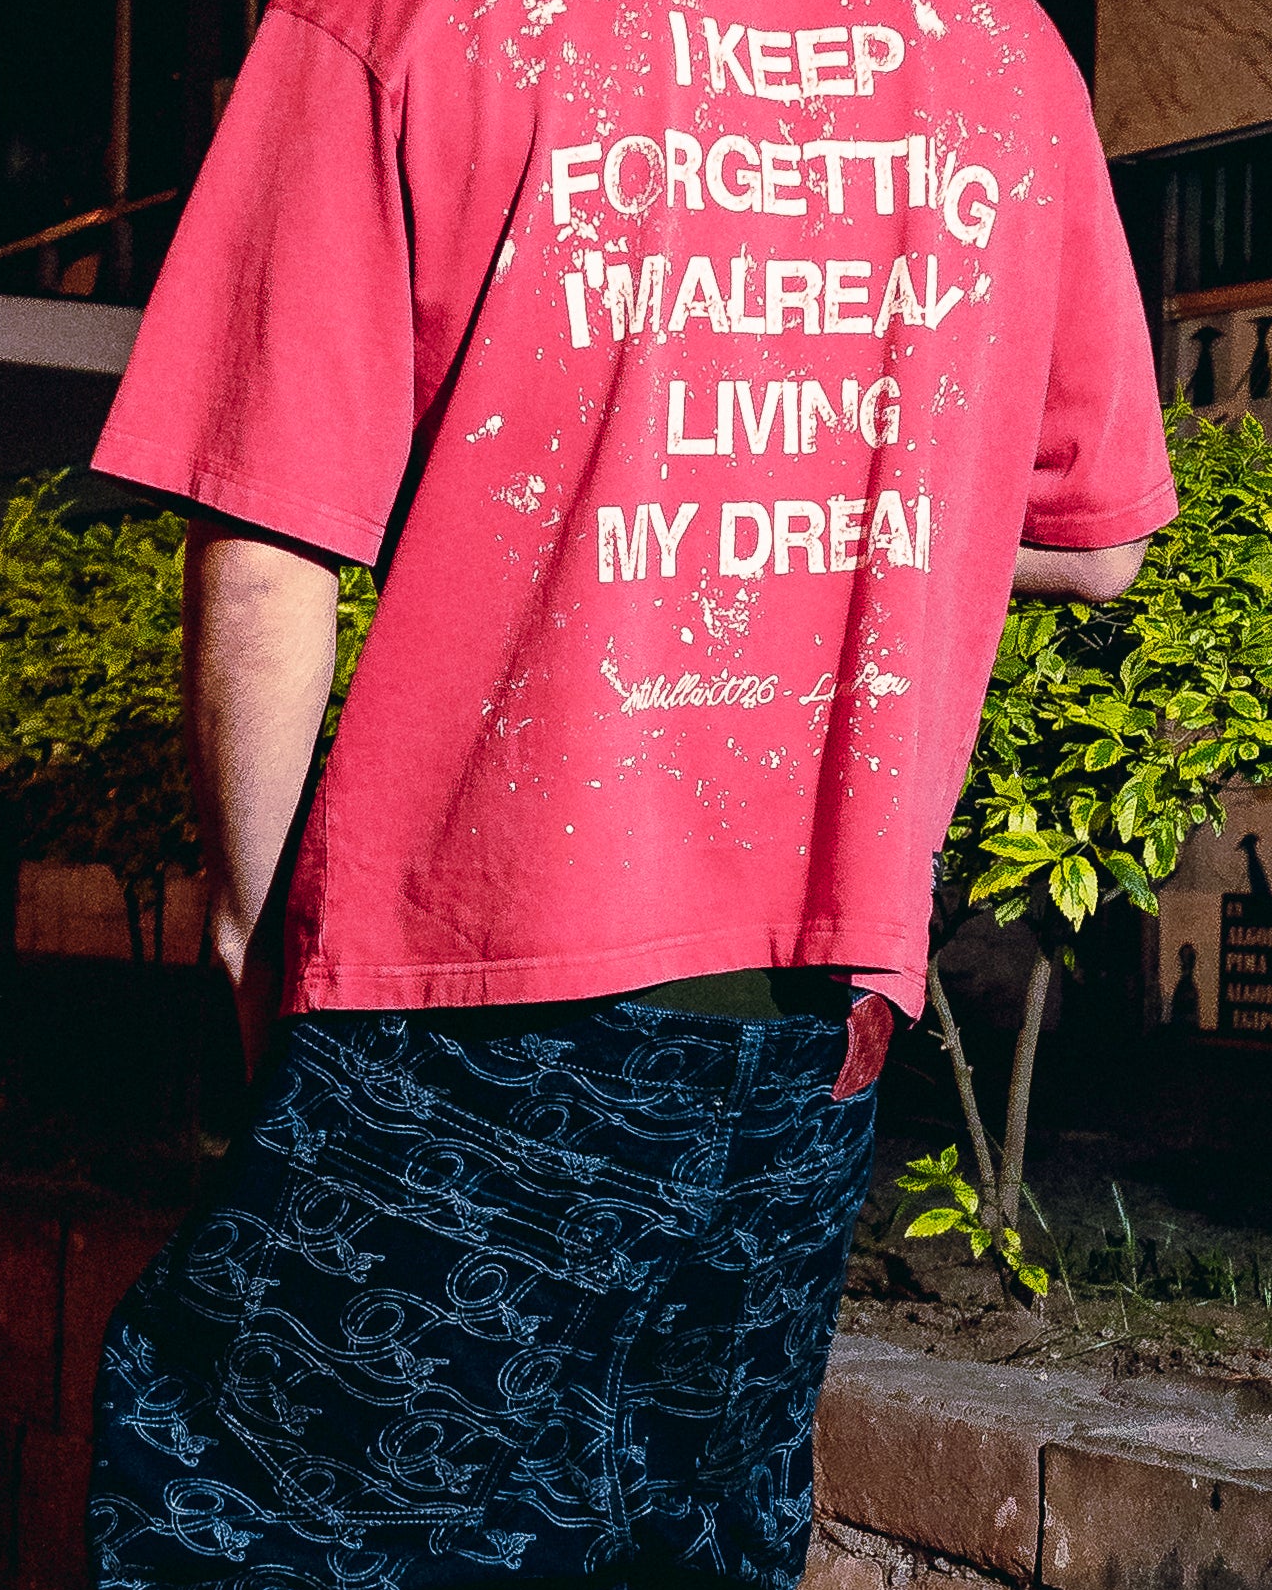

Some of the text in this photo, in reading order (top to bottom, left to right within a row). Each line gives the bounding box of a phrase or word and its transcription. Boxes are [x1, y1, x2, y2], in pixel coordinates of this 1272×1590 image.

[668, 11, 906, 101] I KEEP
[667, 375, 902, 456] LIVING
[597, 502, 700, 583] MY
[1225, 951, 1268, 975] PIMA
